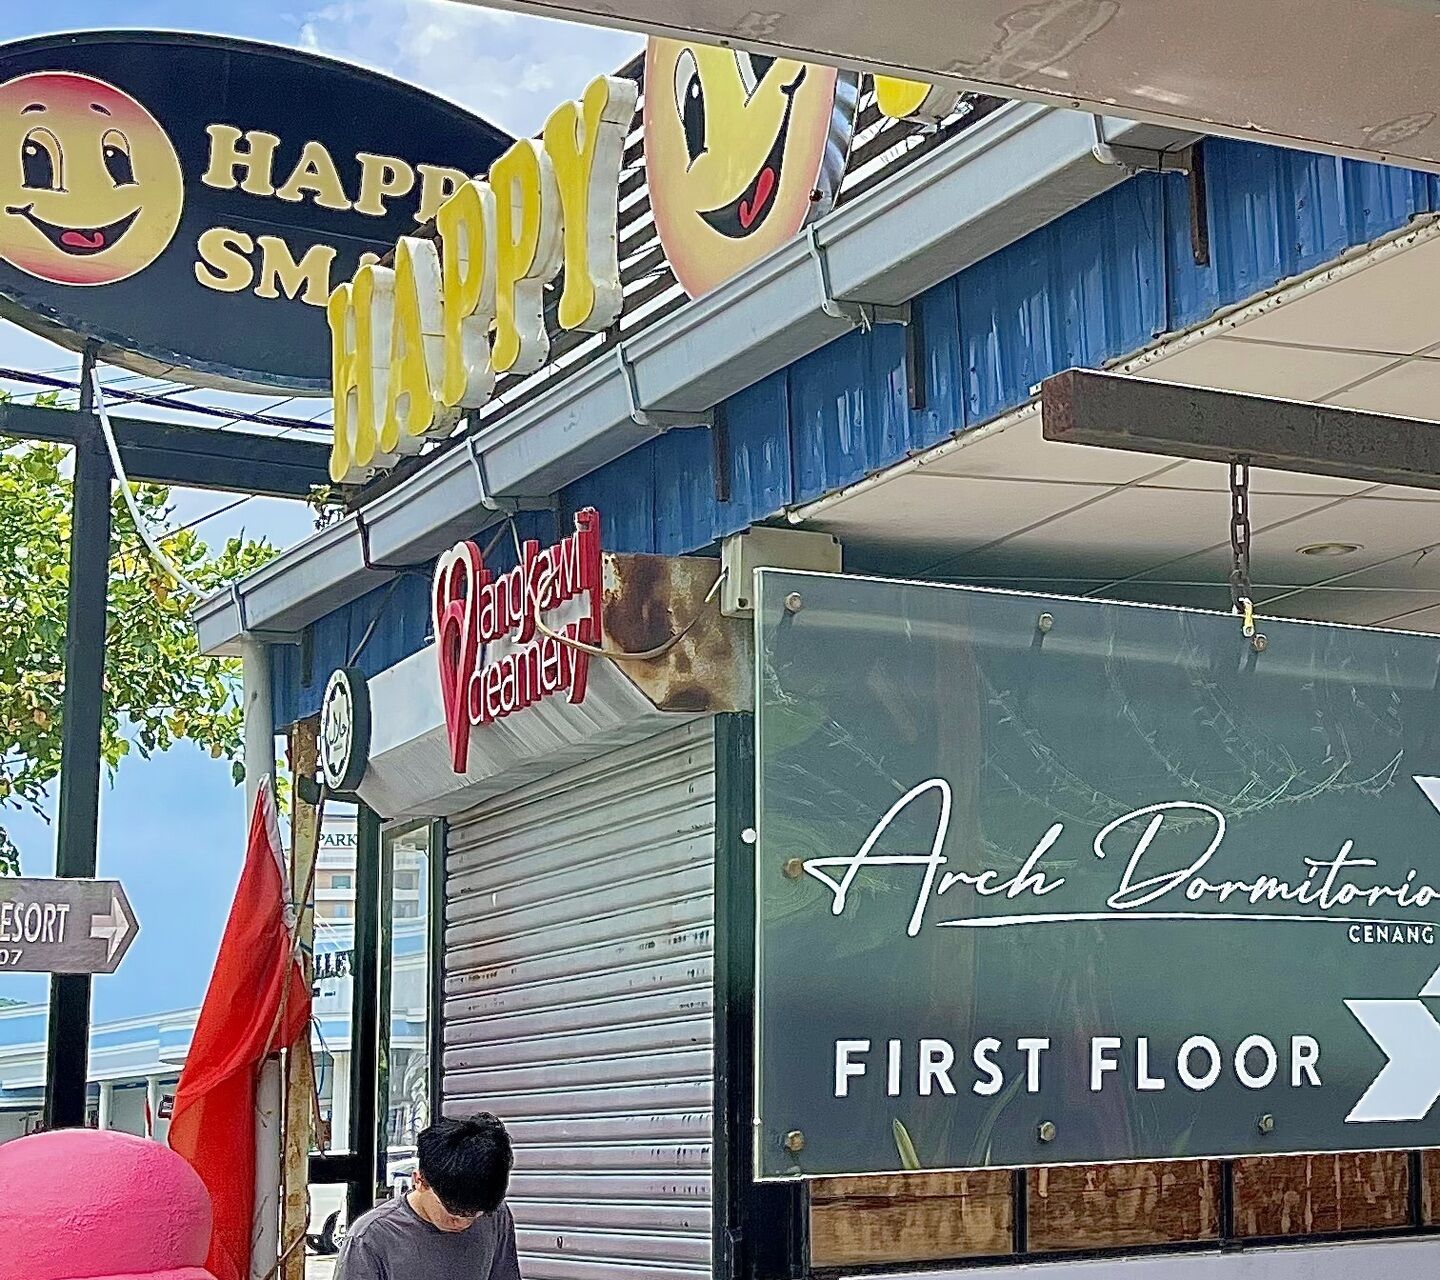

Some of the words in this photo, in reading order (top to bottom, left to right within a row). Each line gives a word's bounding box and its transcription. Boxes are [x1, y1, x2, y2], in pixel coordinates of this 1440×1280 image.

[201, 124, 478, 224] HAPP
[195, 227, 380, 308] SM
[328, 75, 636, 484] HAPPY
[801, 777, 1066, 937] Arch
[1348, 923, 1437, 947] CENANG
[834, 1036, 1050, 1099] FIRST
[1089, 1033, 1323, 1096] FLOOR
